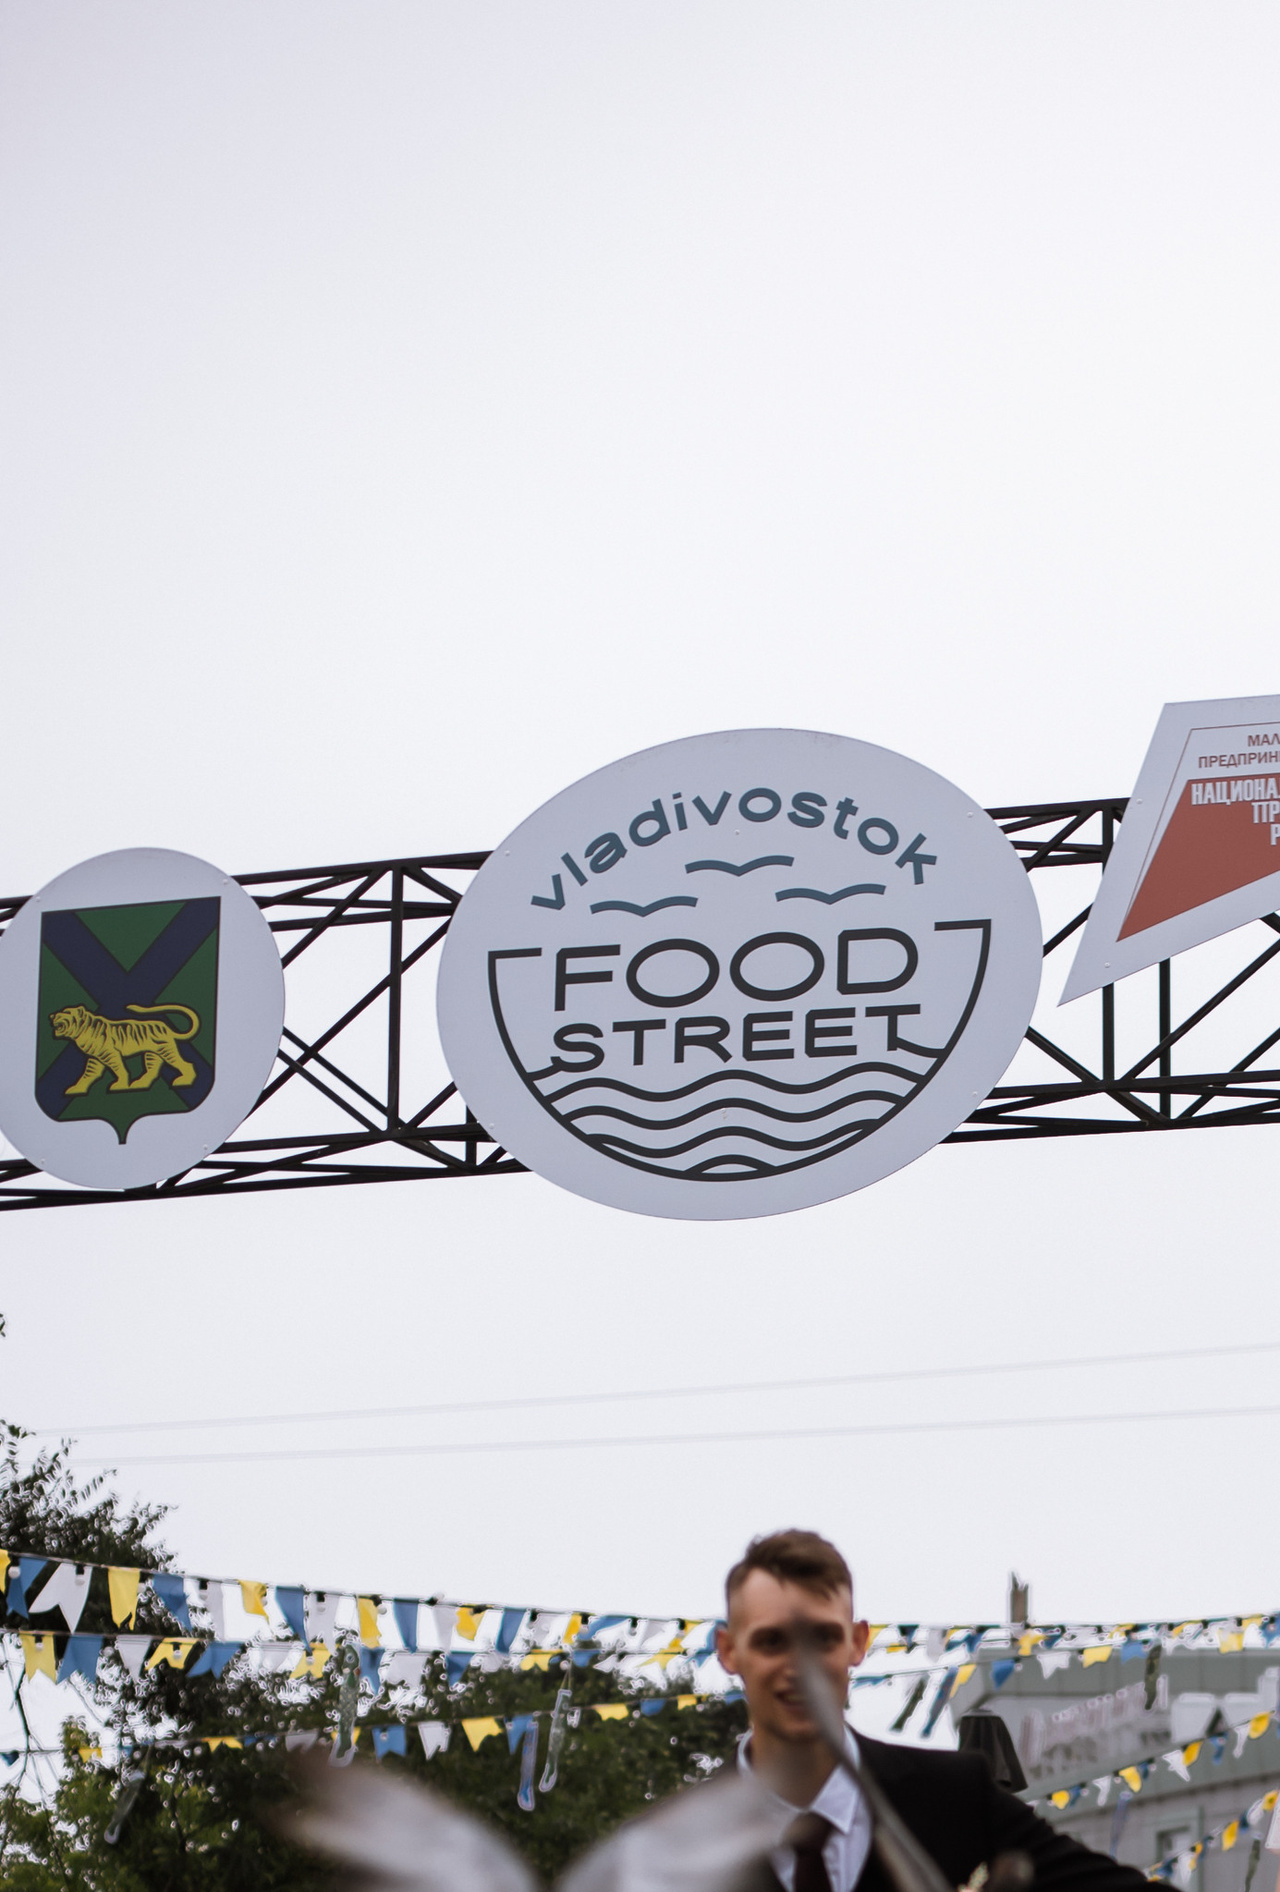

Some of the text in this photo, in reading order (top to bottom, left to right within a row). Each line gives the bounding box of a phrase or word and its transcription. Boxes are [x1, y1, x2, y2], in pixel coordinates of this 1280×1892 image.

[531, 787, 938, 911] vladivostok
[554, 927, 919, 1012] FOOD
[550, 1003, 921, 1073] STREET
